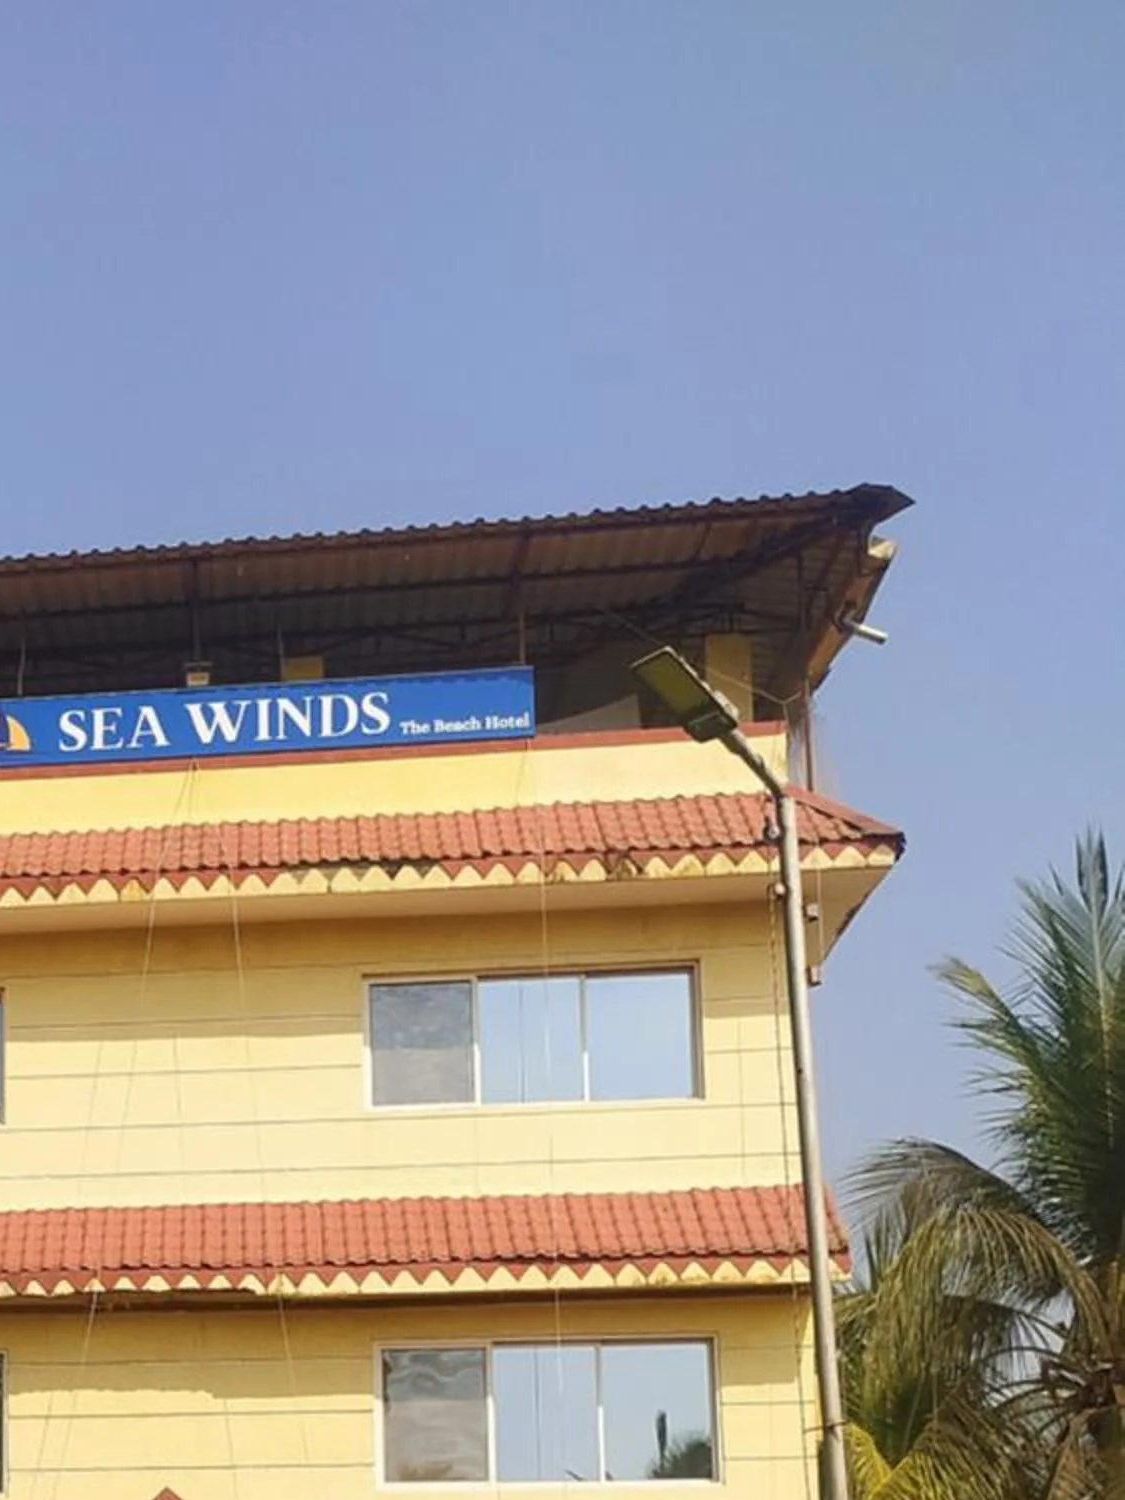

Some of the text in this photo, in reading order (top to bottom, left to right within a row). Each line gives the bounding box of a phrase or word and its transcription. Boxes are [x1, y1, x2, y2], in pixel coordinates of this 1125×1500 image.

[58, 691, 391, 751] SEA WINDS
[400, 712, 531, 735] The Beach Hotel
